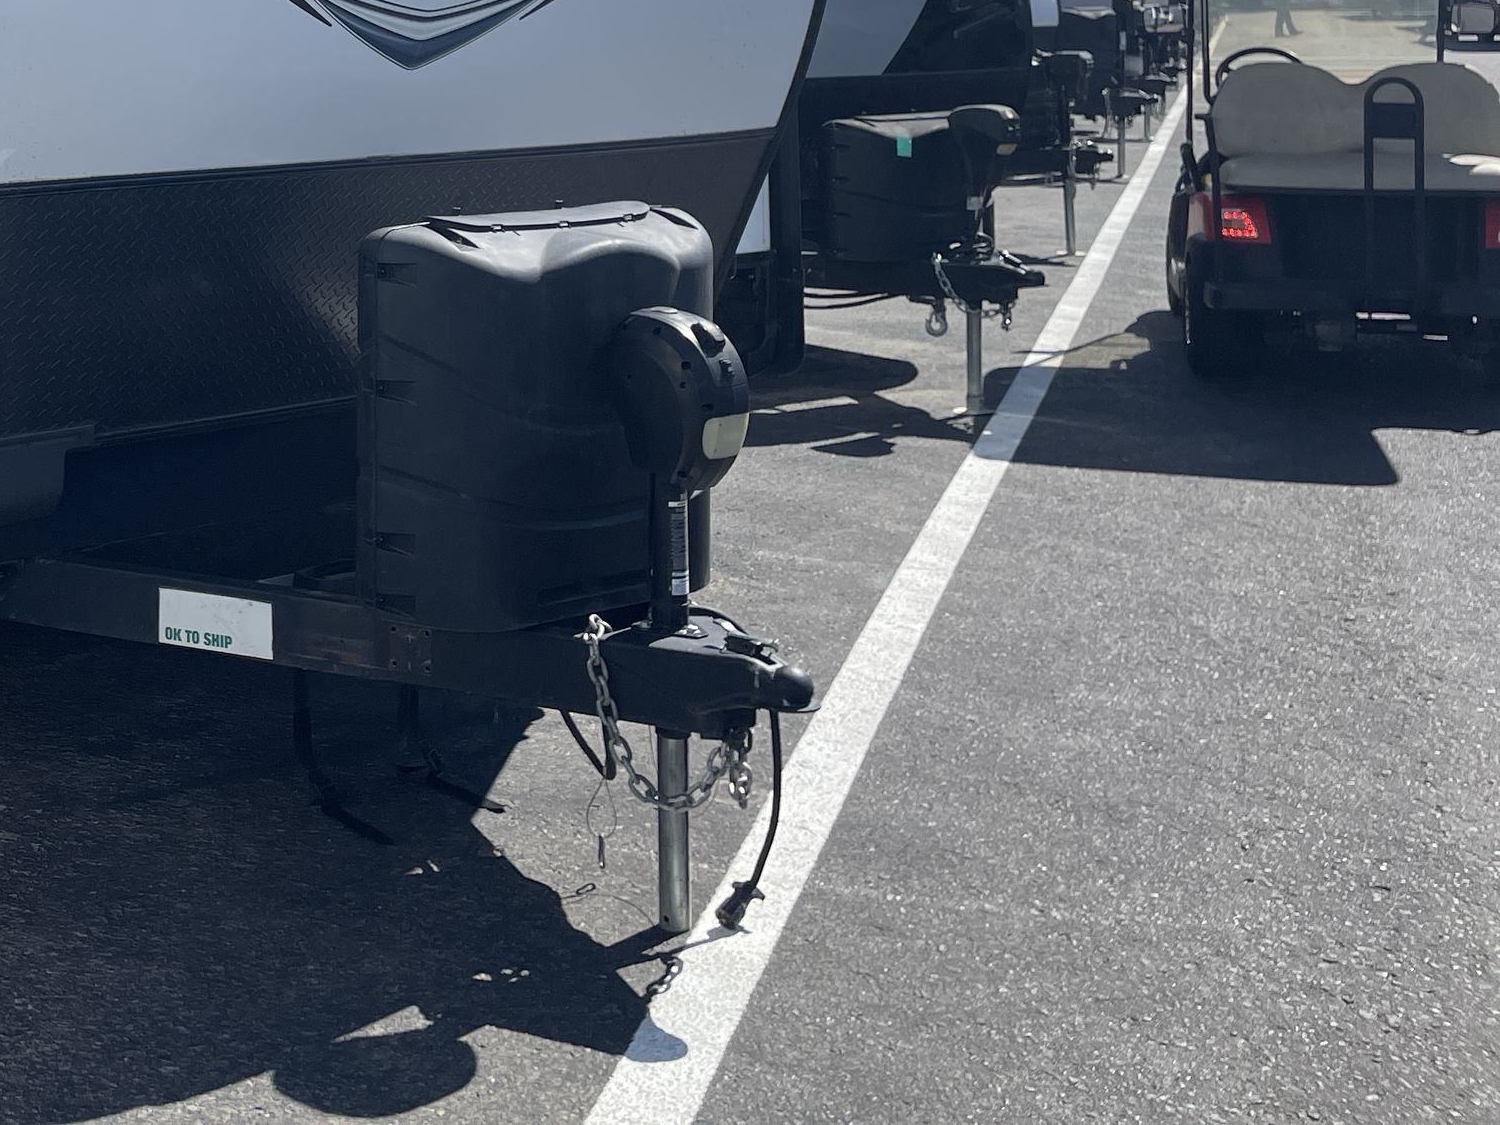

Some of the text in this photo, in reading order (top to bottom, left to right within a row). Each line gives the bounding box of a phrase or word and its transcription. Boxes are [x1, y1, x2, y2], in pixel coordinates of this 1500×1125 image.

[165, 627, 233, 649] OK TO SHIP
